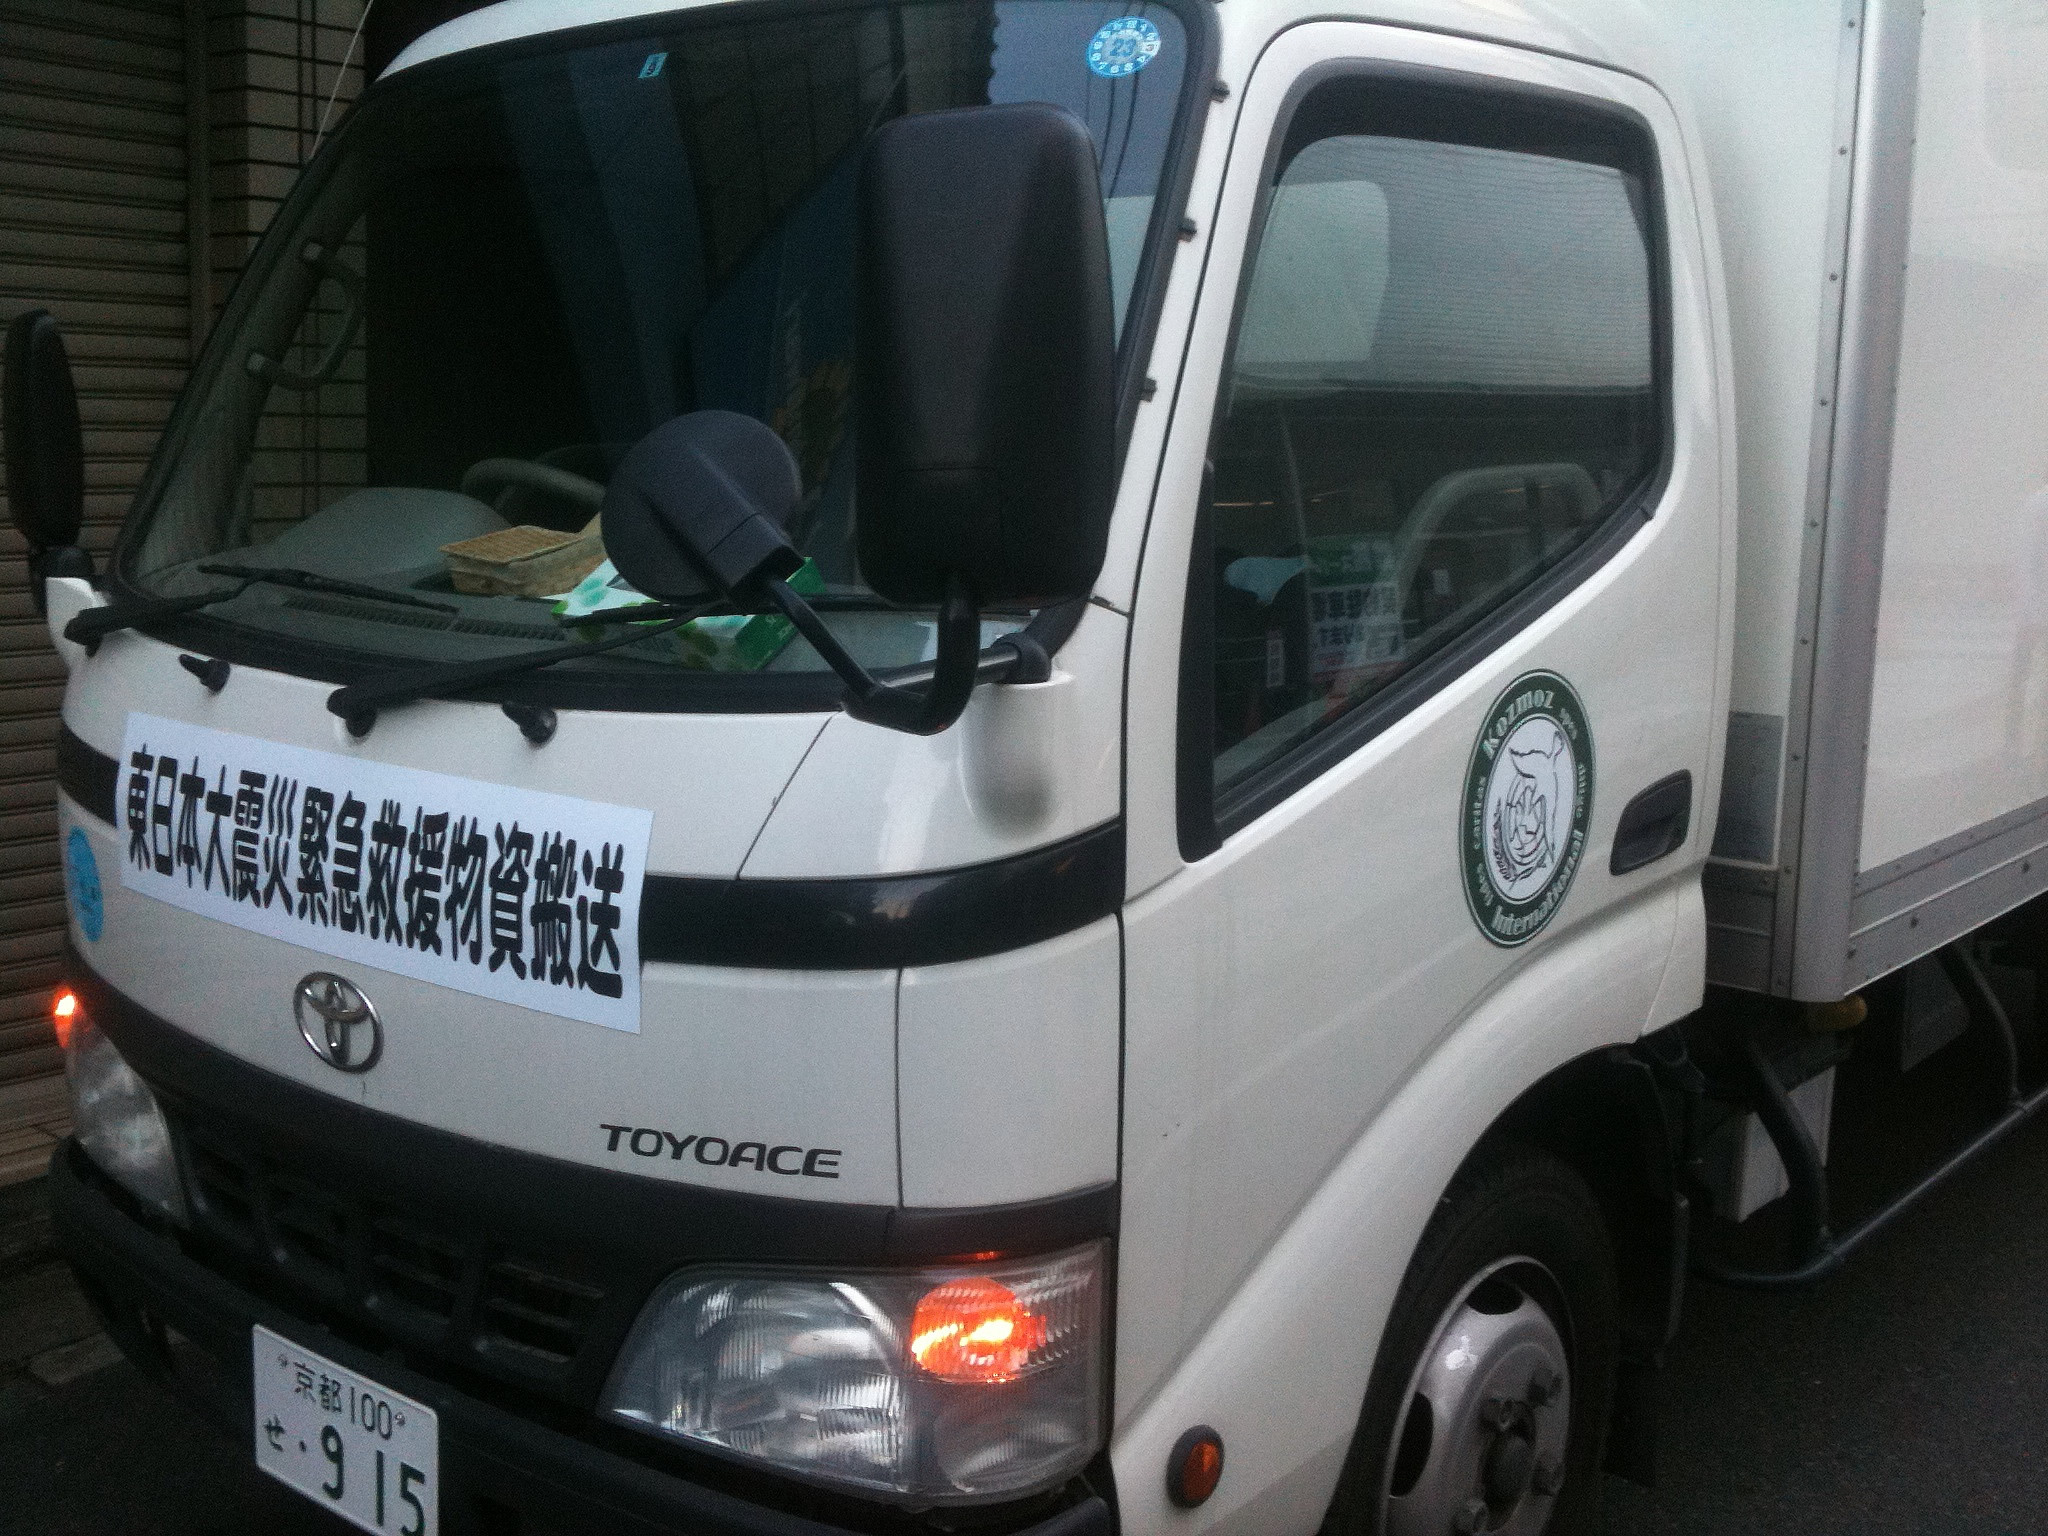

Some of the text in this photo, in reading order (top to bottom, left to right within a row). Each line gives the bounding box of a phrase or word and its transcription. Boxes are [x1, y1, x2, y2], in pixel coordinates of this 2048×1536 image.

[1482, 689, 1554, 760] Kozmoz
[128, 744, 624, 998] 東日本大震災緊急救援物資搬送
[1491, 829, 1584, 936] International
[600, 1124, 842, 1178] TOYOACE
